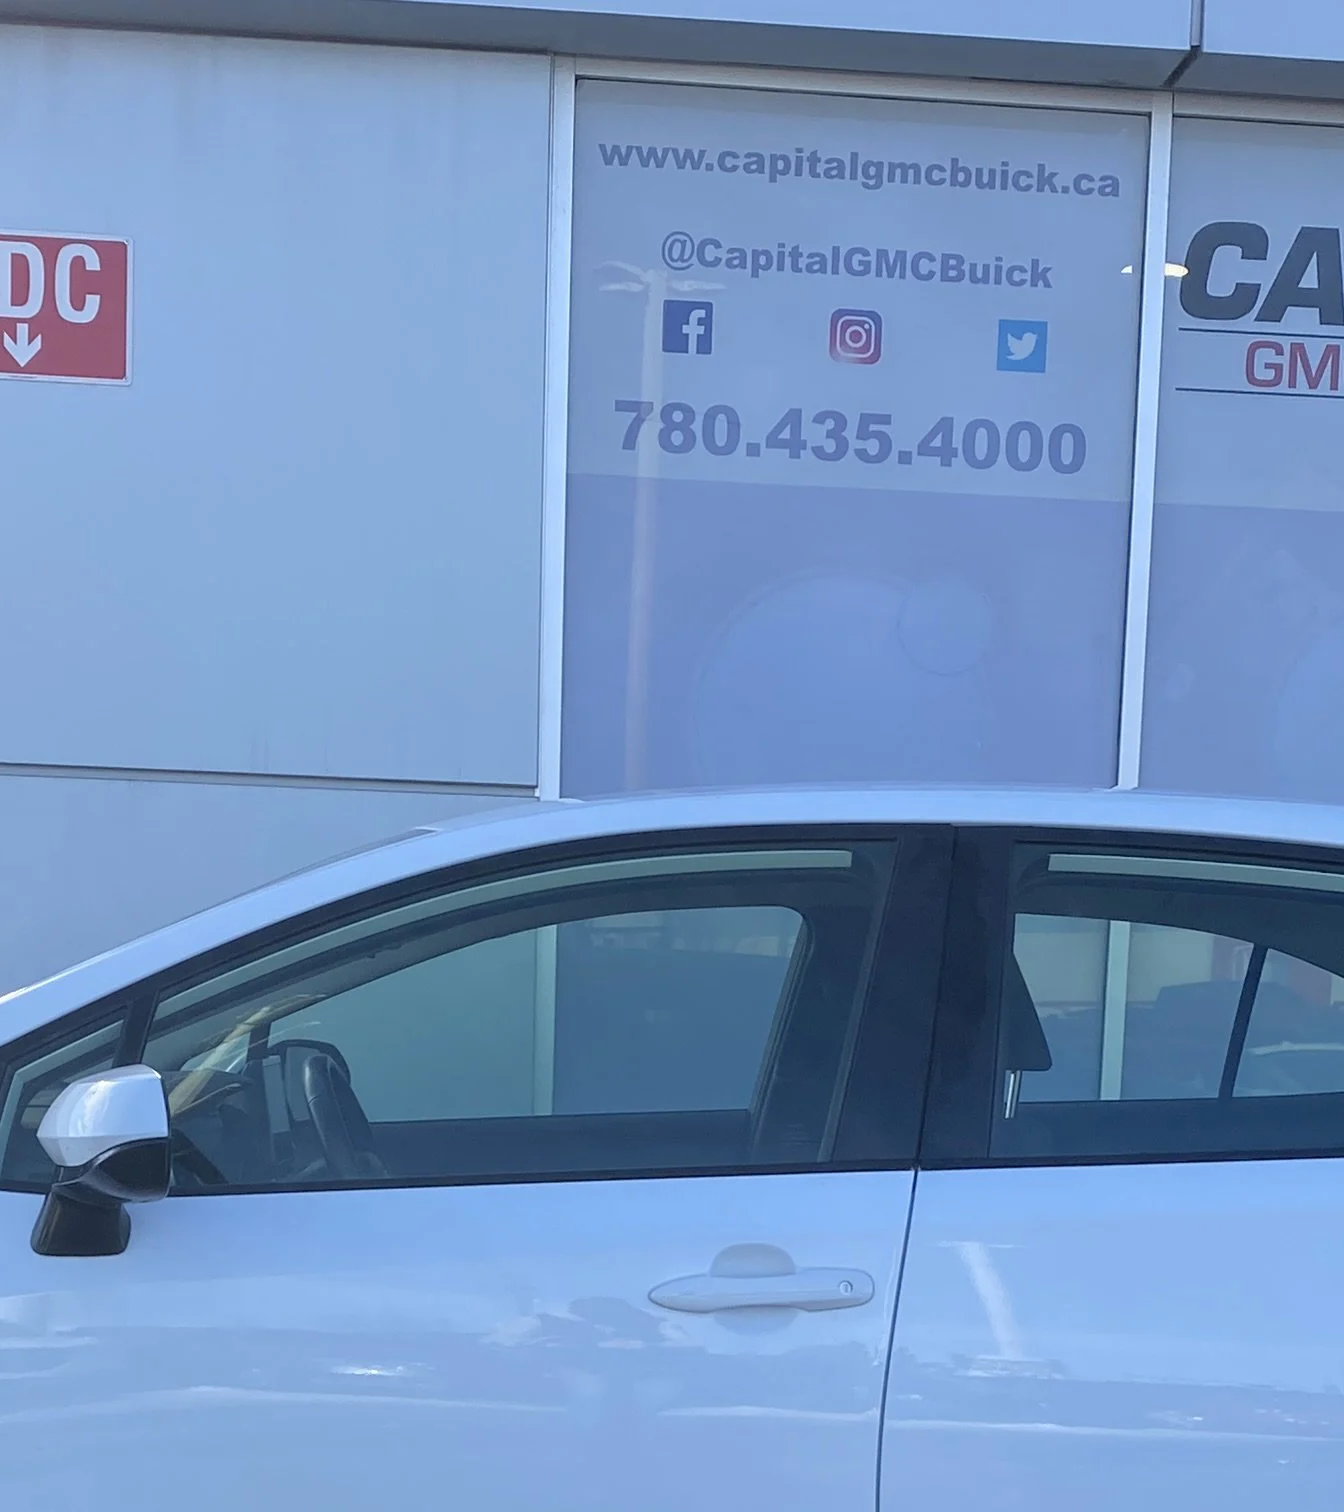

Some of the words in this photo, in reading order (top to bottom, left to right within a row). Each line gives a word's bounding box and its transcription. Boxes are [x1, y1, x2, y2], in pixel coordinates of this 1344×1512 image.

[598, 142, 1122, 198] www.capitalgmcbuick.ca
[661, 230, 1054, 290] @CapitalGMCBuick
[613, 399, 1088, 475] 780.435.4000
